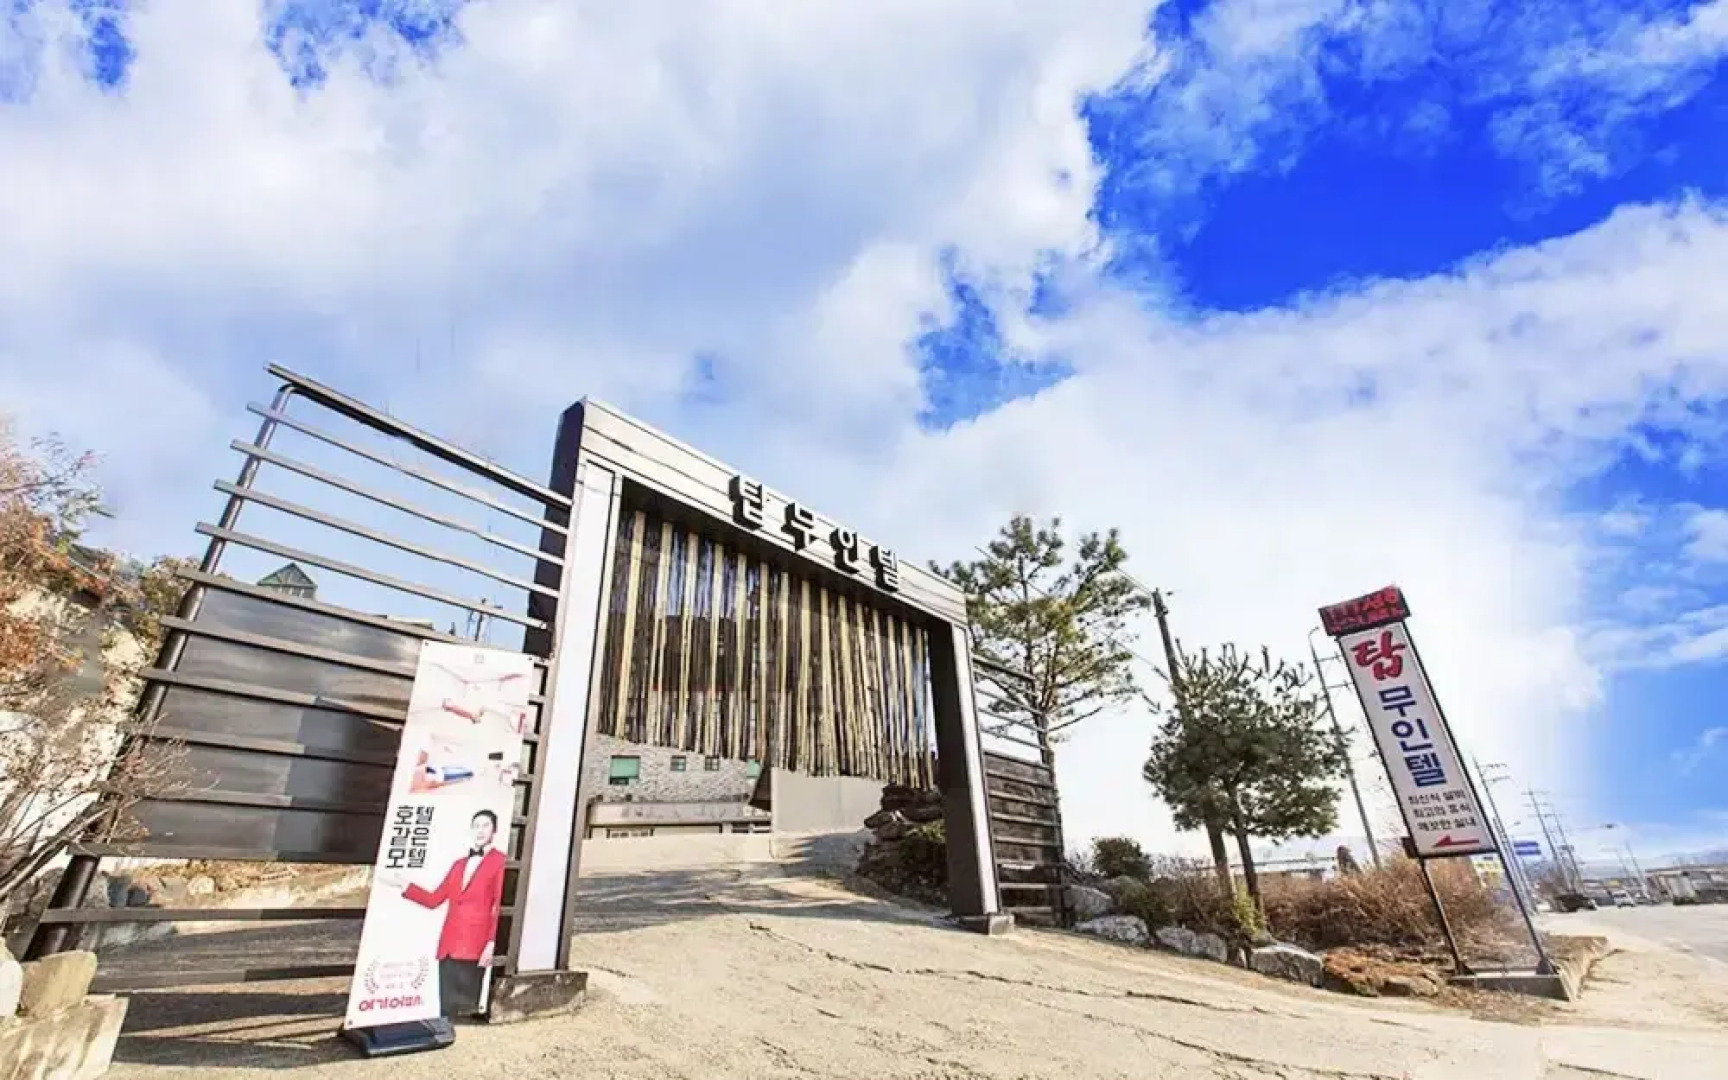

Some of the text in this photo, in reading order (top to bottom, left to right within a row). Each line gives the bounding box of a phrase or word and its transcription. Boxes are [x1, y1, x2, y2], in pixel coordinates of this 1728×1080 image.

[1351, 630, 1406, 681] 탑
[1378, 685, 1447, 788] 무인텔
[394, 805, 434, 825] 호텔
[385, 847, 426, 869] 모텔
